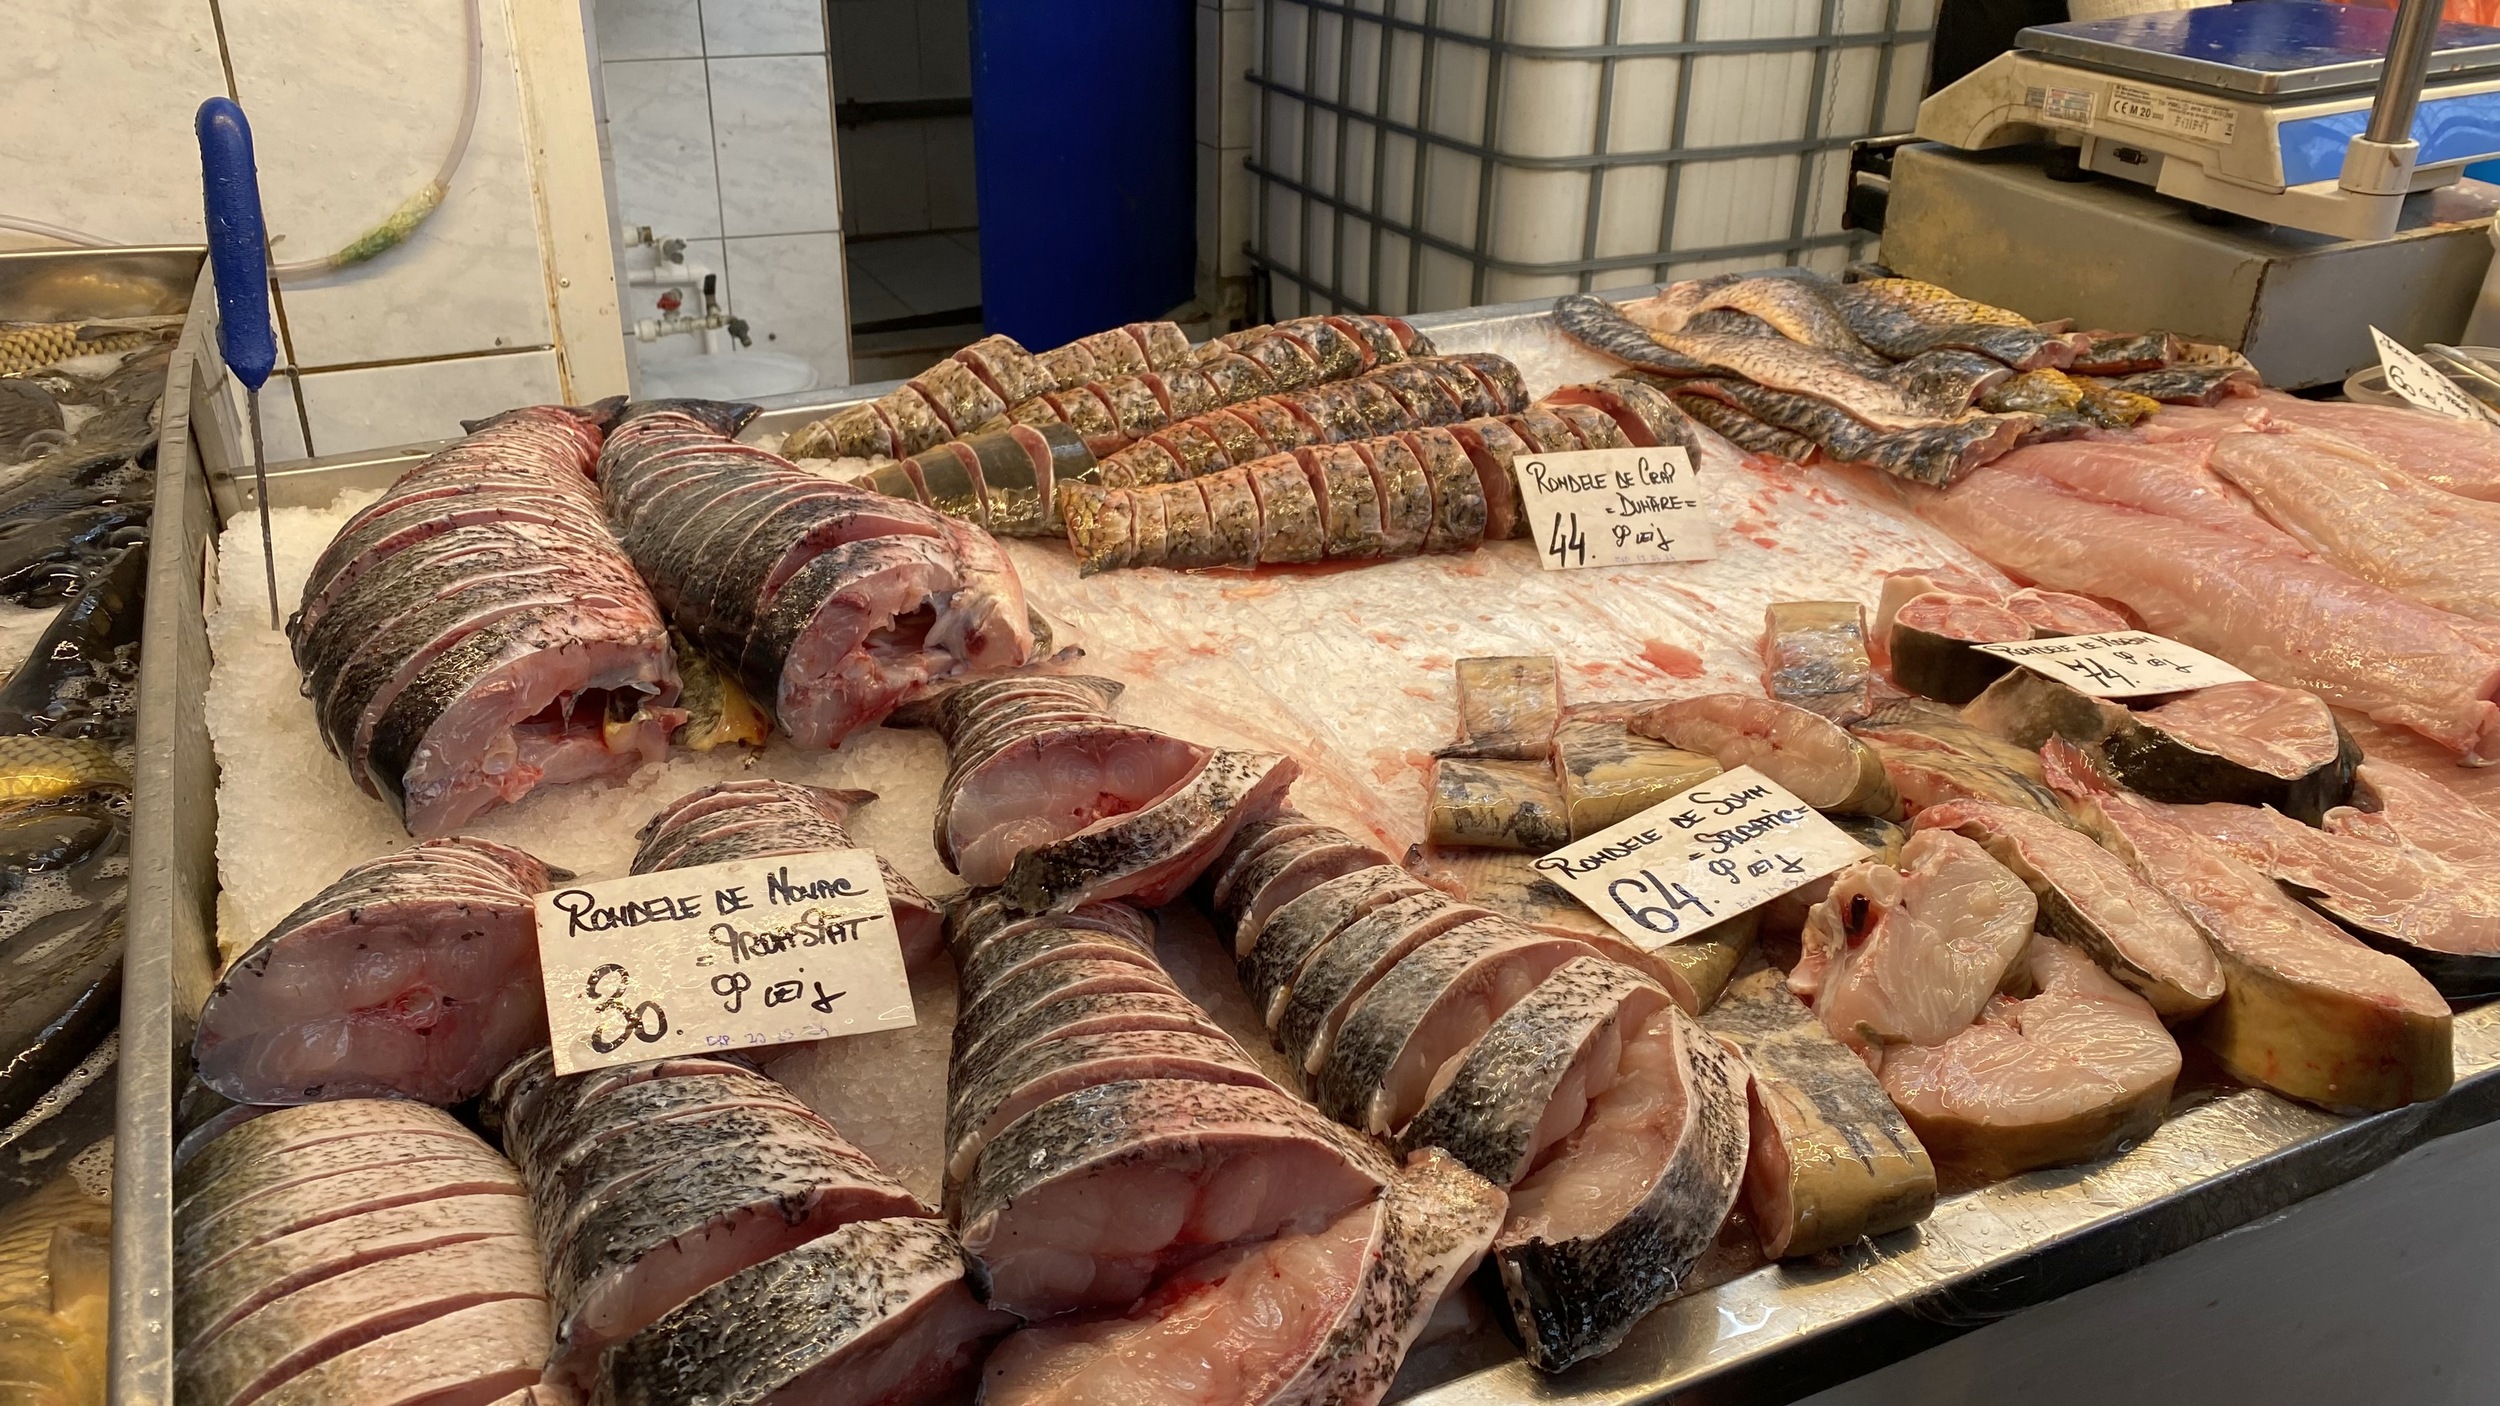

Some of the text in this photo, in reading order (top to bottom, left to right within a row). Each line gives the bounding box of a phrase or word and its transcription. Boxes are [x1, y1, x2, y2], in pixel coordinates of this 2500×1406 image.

[2130, 105, 2139, 115] M
[2140, 107, 2151, 119] 20
[1526, 457, 1676, 494] RONDELE DE CRAP
[1535, 828, 1663, 880] RONDELE
[1669, 809, 1706, 829] DE
[553, 889, 701, 937] RONDELE
[715, 886, 753, 916] DE
